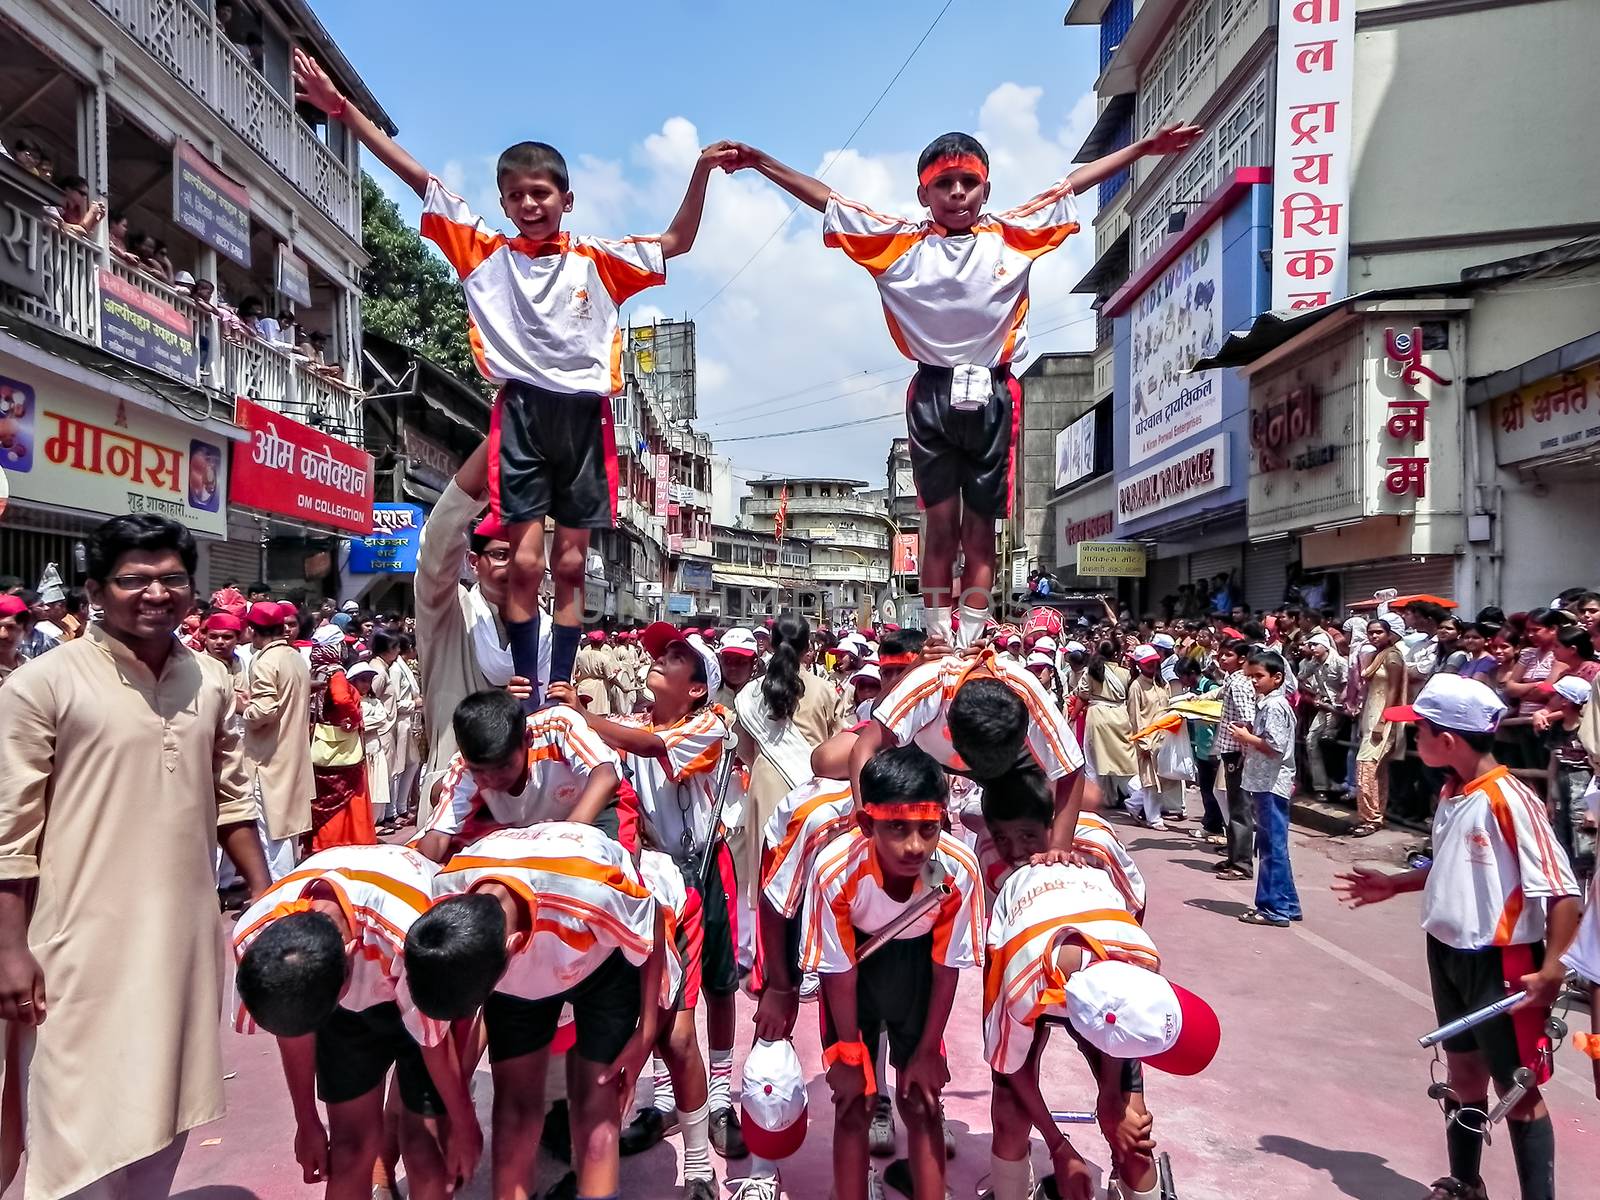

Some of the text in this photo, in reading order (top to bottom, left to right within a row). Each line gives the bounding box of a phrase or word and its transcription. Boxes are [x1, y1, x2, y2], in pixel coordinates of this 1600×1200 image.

[1139, 238, 1210, 322] KIDS WORLD
[1135, 408, 1163, 436] पोरवाल
[1164, 378, 1213, 424] ट्रायसिकल
[1174, 414, 1202, 437] Enterprises
[1384, 327, 1452, 498] पूनम
[1501, 391, 1524, 434] श्री
[1531, 374, 1588, 424] अनंत
[43, 410, 184, 493] मानस
[252, 421, 367, 498] ओम कलेक्शन
[1159, 447, 1215, 500] TRICYCLE
[297, 494, 364, 523] OM COLLECTION
